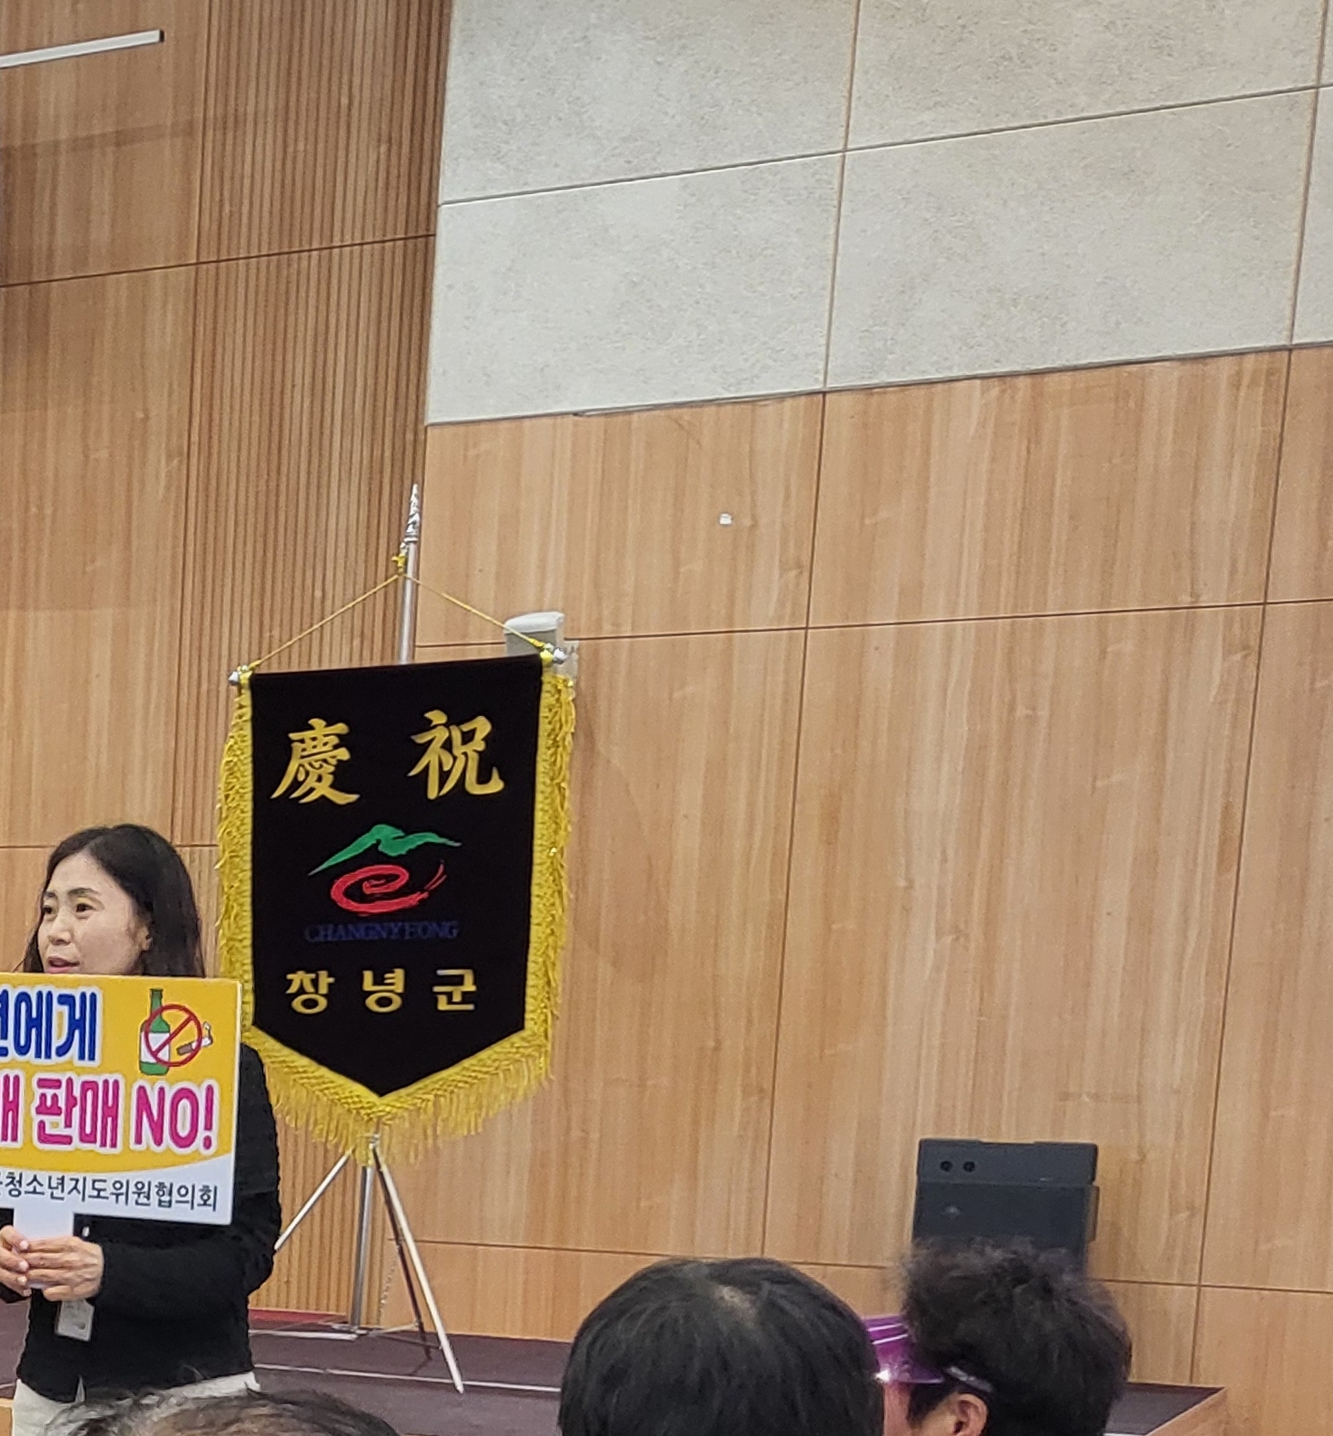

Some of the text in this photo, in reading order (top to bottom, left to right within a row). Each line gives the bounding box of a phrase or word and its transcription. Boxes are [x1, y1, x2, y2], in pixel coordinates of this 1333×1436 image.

[304, 921, 460, 942] CHANGNYEONG
[35, 1077, 120, 1149] 판매
[134, 1083, 215, 1151] NO!
